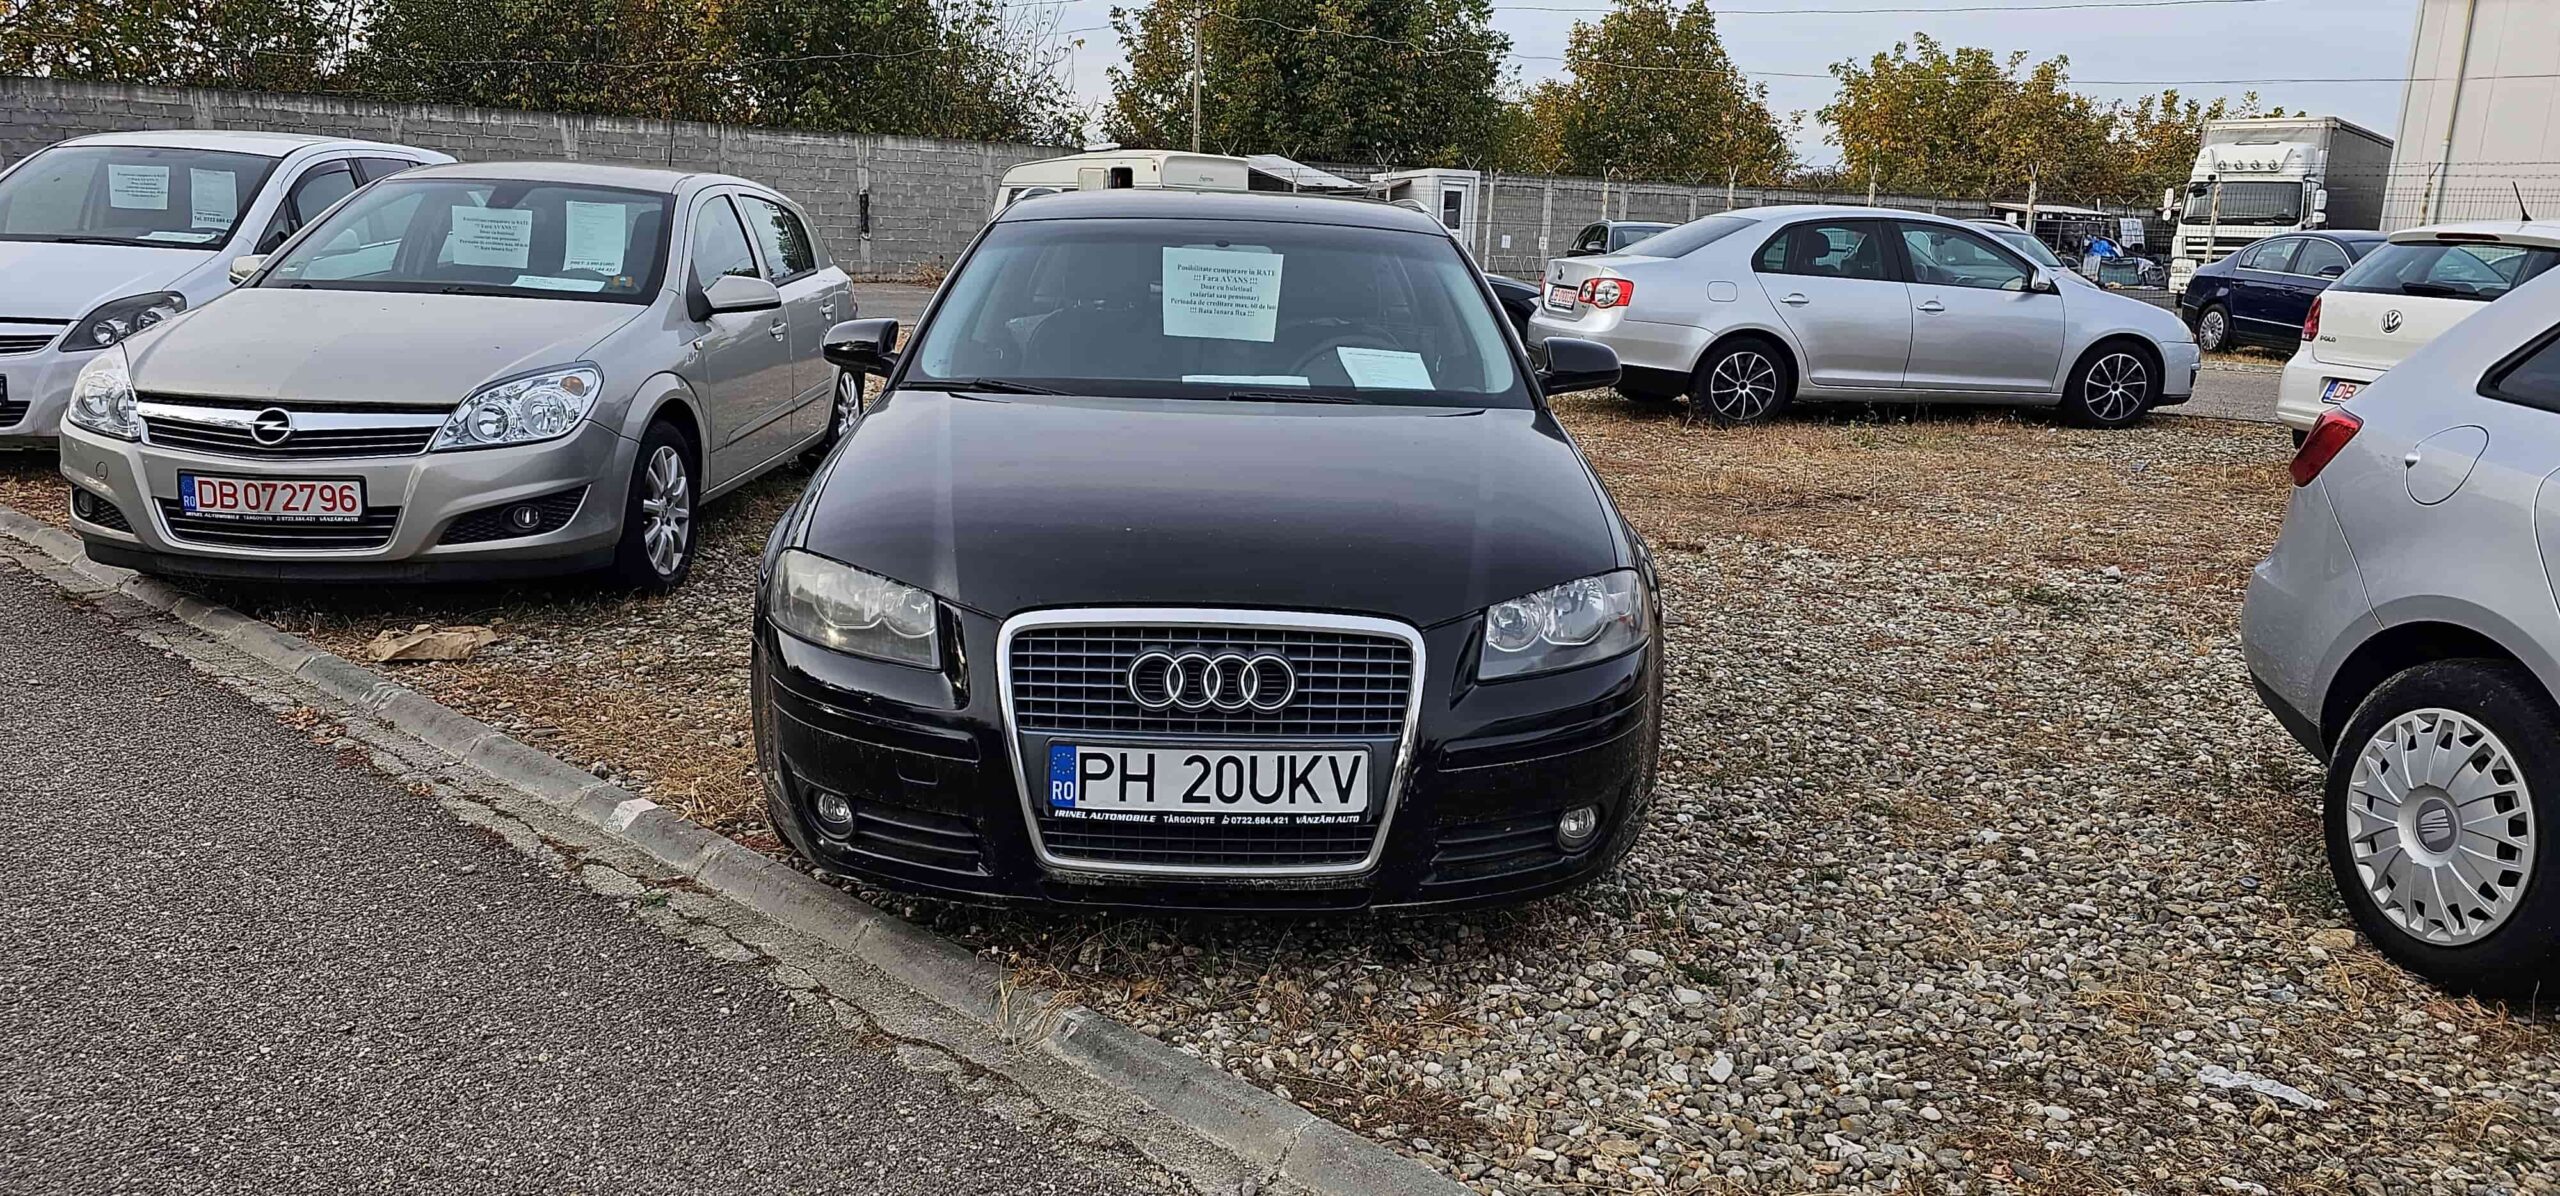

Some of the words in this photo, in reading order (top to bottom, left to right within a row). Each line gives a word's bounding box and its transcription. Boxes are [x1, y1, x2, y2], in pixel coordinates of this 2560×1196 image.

[1202, 274, 1219, 282] Fara
[1220, 276, 1248, 284] AVANS
[2332, 383, 2357, 400] DB
[183, 495, 196, 508] RO
[197, 479, 239, 510] DB
[243, 482, 358, 512] 072796
[1052, 780, 1075, 801] RO
[1078, 752, 1156, 803] PH
[1181, 754, 1363, 805] 20UKV
[1054, 809, 1088, 819] IRINEL
[1089, 811, 1157, 823] AUTOMOBILE
[1230, 816, 1289, 825] 0722.684.421
[1336, 815, 1360, 823] AUTO
